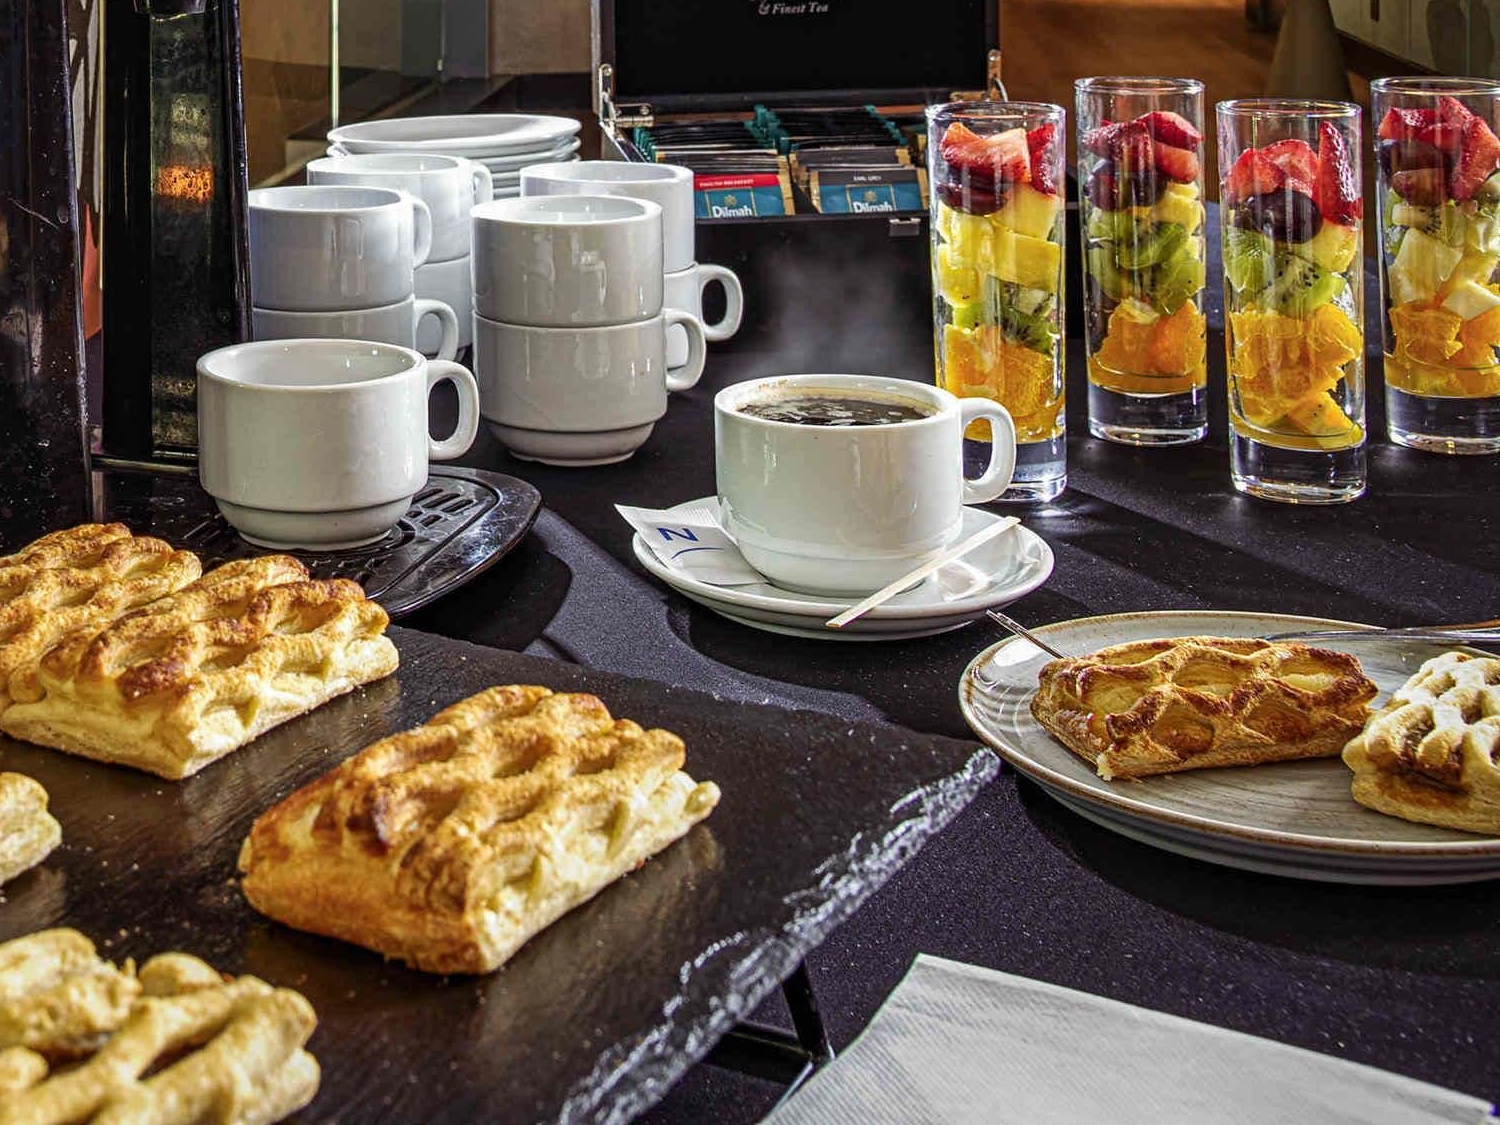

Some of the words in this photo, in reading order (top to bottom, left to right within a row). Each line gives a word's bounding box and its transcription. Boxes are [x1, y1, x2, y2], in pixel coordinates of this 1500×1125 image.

[772, 2, 807, 15] Finest
[808, 1, 829, 13] Tea
[711, 205, 753, 218] Dilmah
[853, 201, 893, 213] Dilmah
